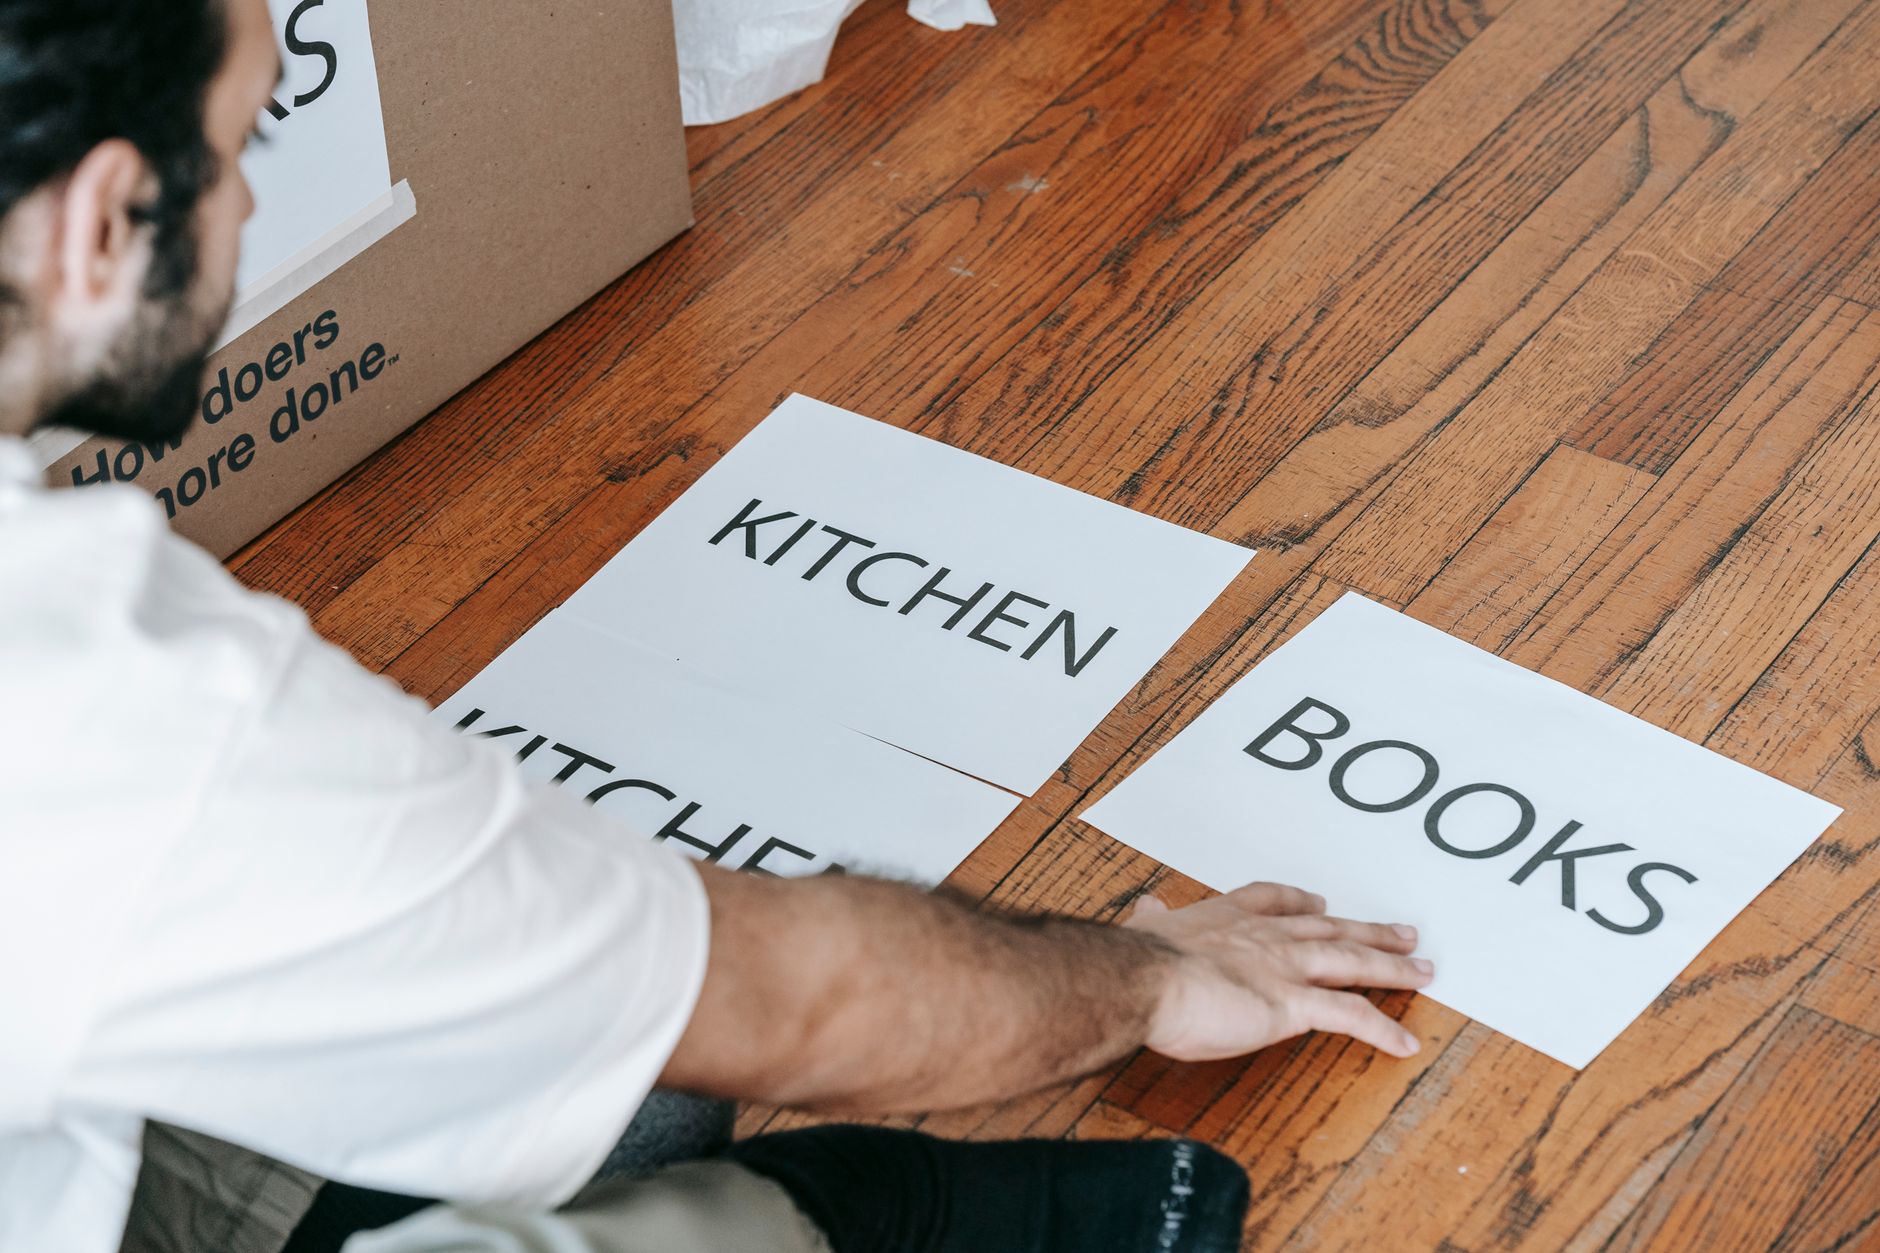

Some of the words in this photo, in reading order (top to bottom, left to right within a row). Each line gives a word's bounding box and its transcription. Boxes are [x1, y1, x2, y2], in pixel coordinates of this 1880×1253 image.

[202, 309, 339, 424] doers
[708, 498, 1119, 678] KITCHEN
[1242, 696, 1699, 936] BOOKS
